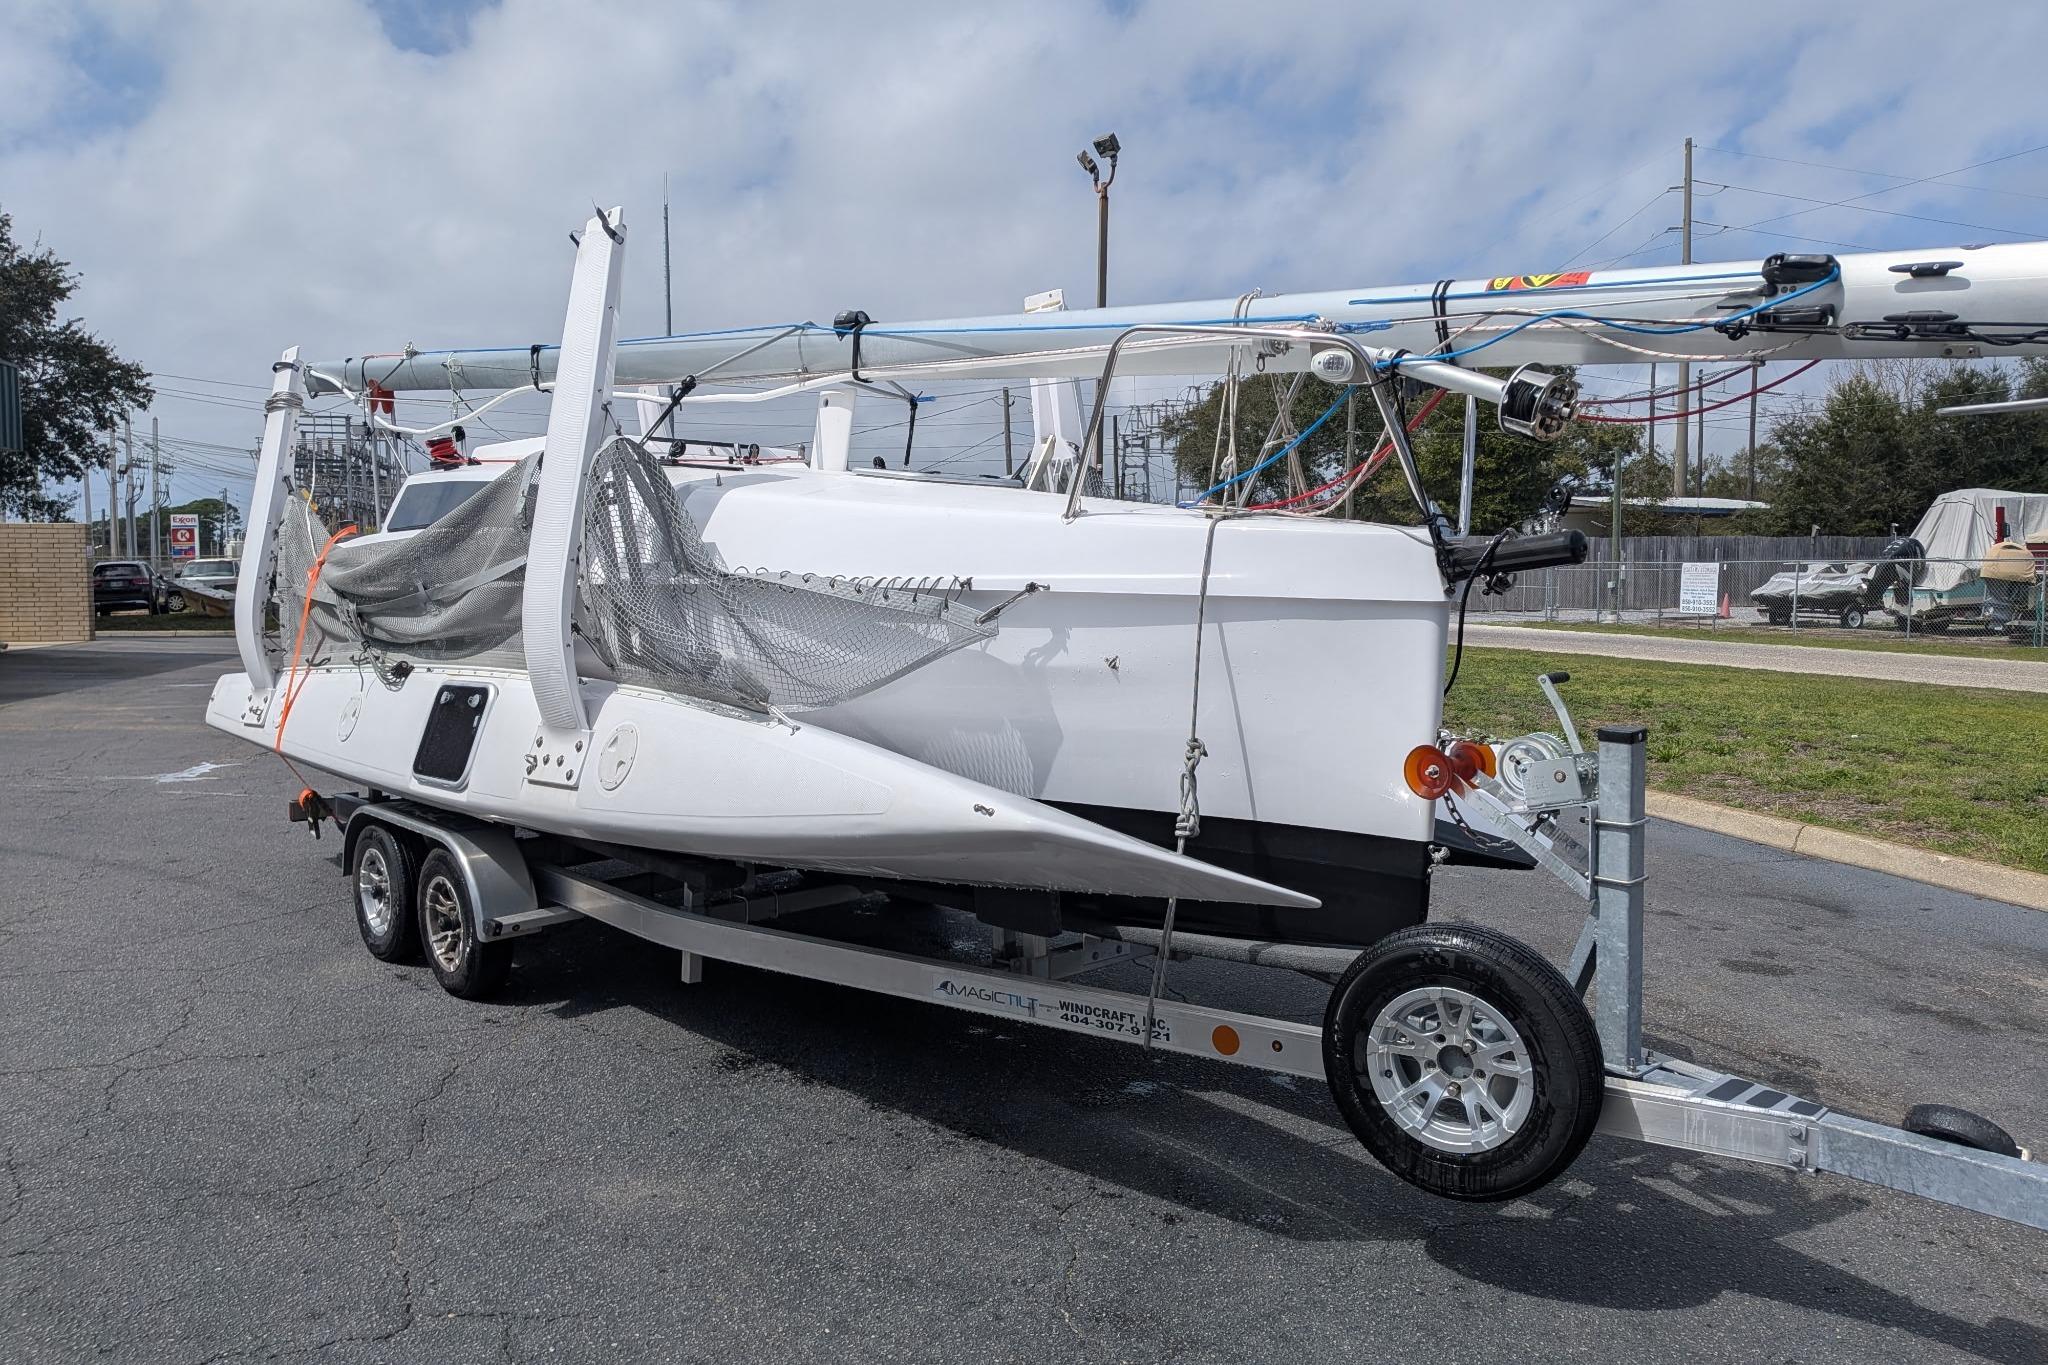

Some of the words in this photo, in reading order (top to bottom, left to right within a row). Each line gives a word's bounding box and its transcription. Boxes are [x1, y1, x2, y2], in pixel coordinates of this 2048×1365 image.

[173, 516, 196, 524] Exxon
[1059, 999, 1137, 1026] WINDCRAFT,
[1060, 1013, 1170, 1041] 404-307-921
